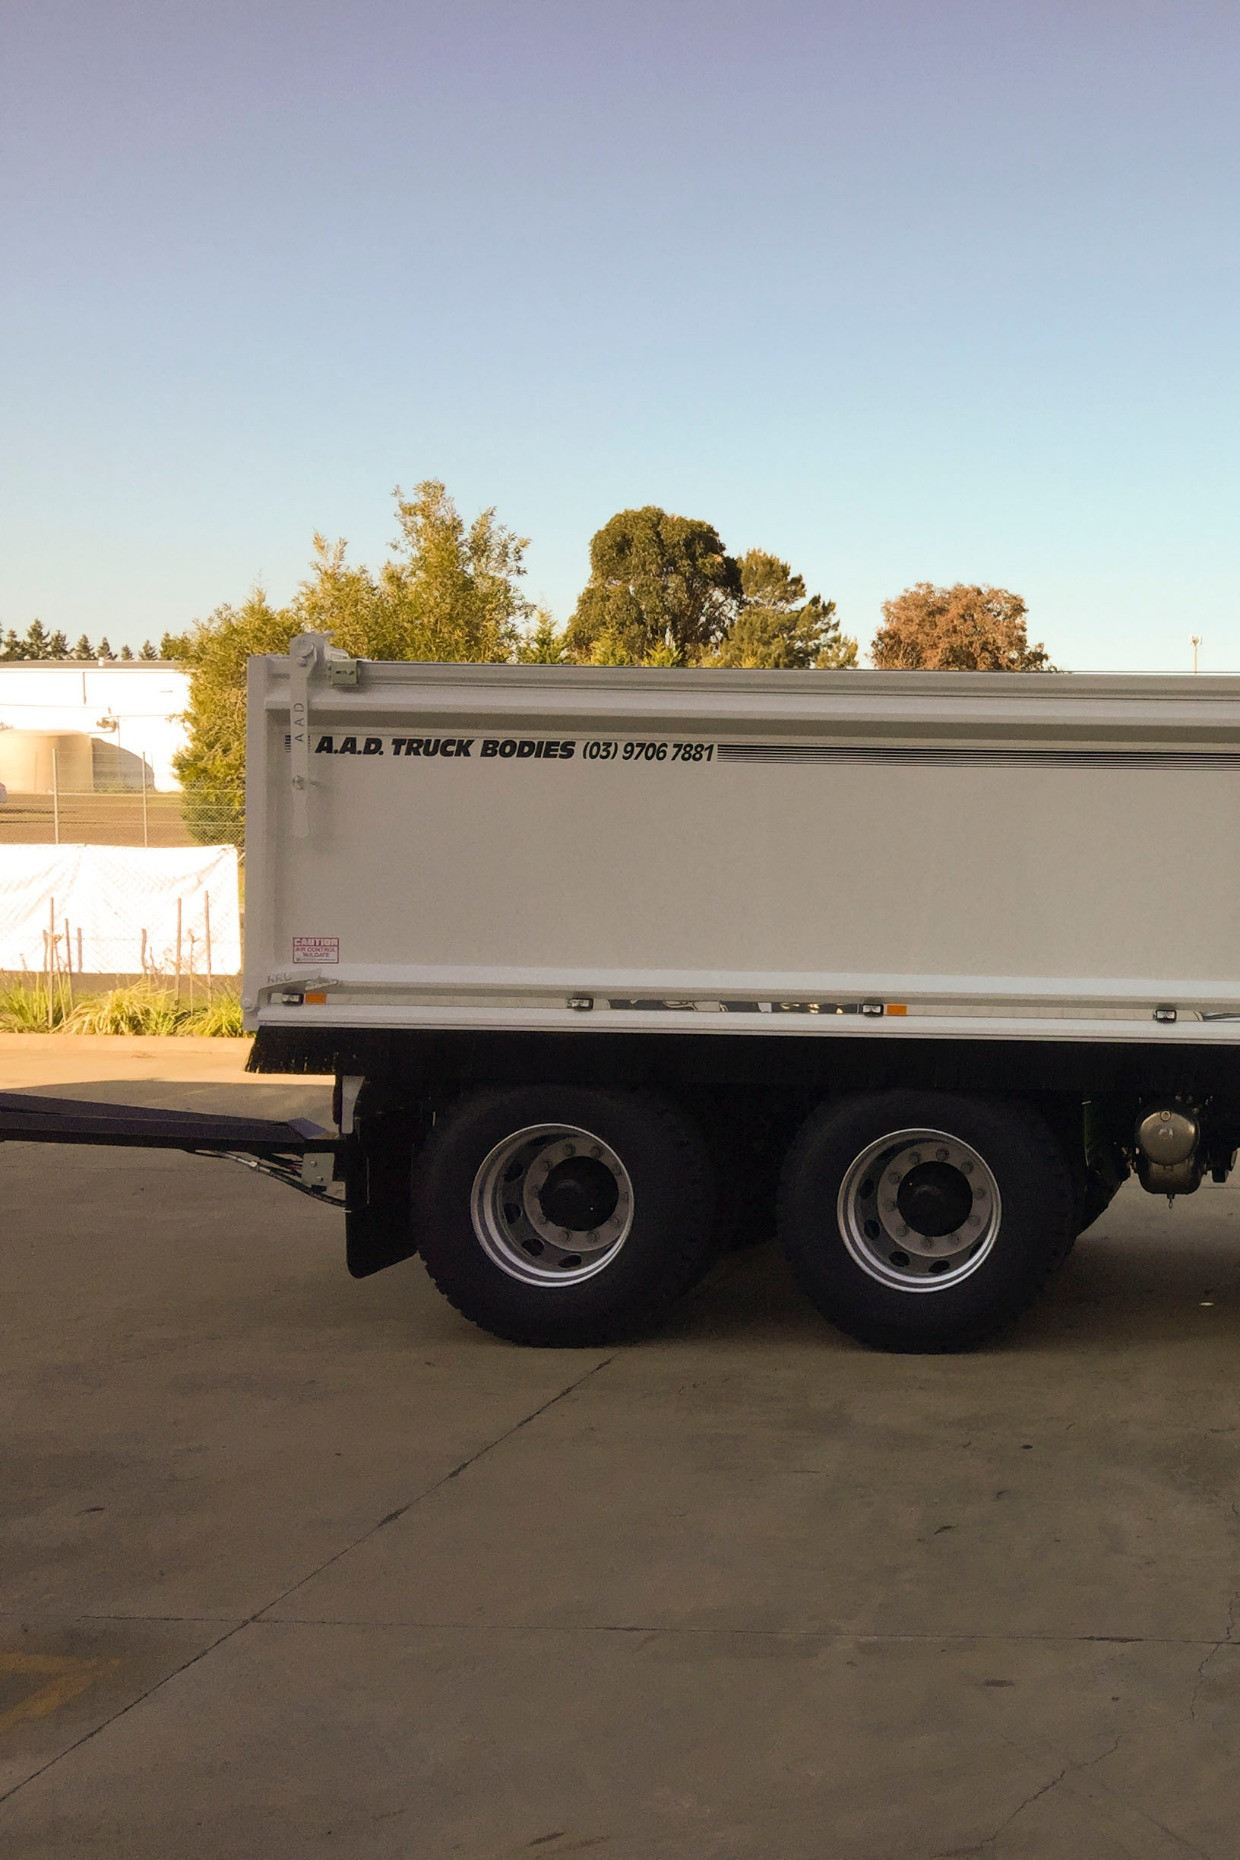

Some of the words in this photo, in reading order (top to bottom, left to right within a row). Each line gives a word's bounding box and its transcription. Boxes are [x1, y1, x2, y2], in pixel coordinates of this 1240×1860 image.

[293, 702, 304, 742] AAD
[315, 736, 384, 755] A.A.D.
[392, 738, 475, 757] TRUCK
[480, 739, 576, 759] BODIES
[582, 741, 618, 760] (03)
[622, 742, 668, 761] 9706
[671, 743, 714, 762] 7881
[294, 938, 338, 946] CAUTION
